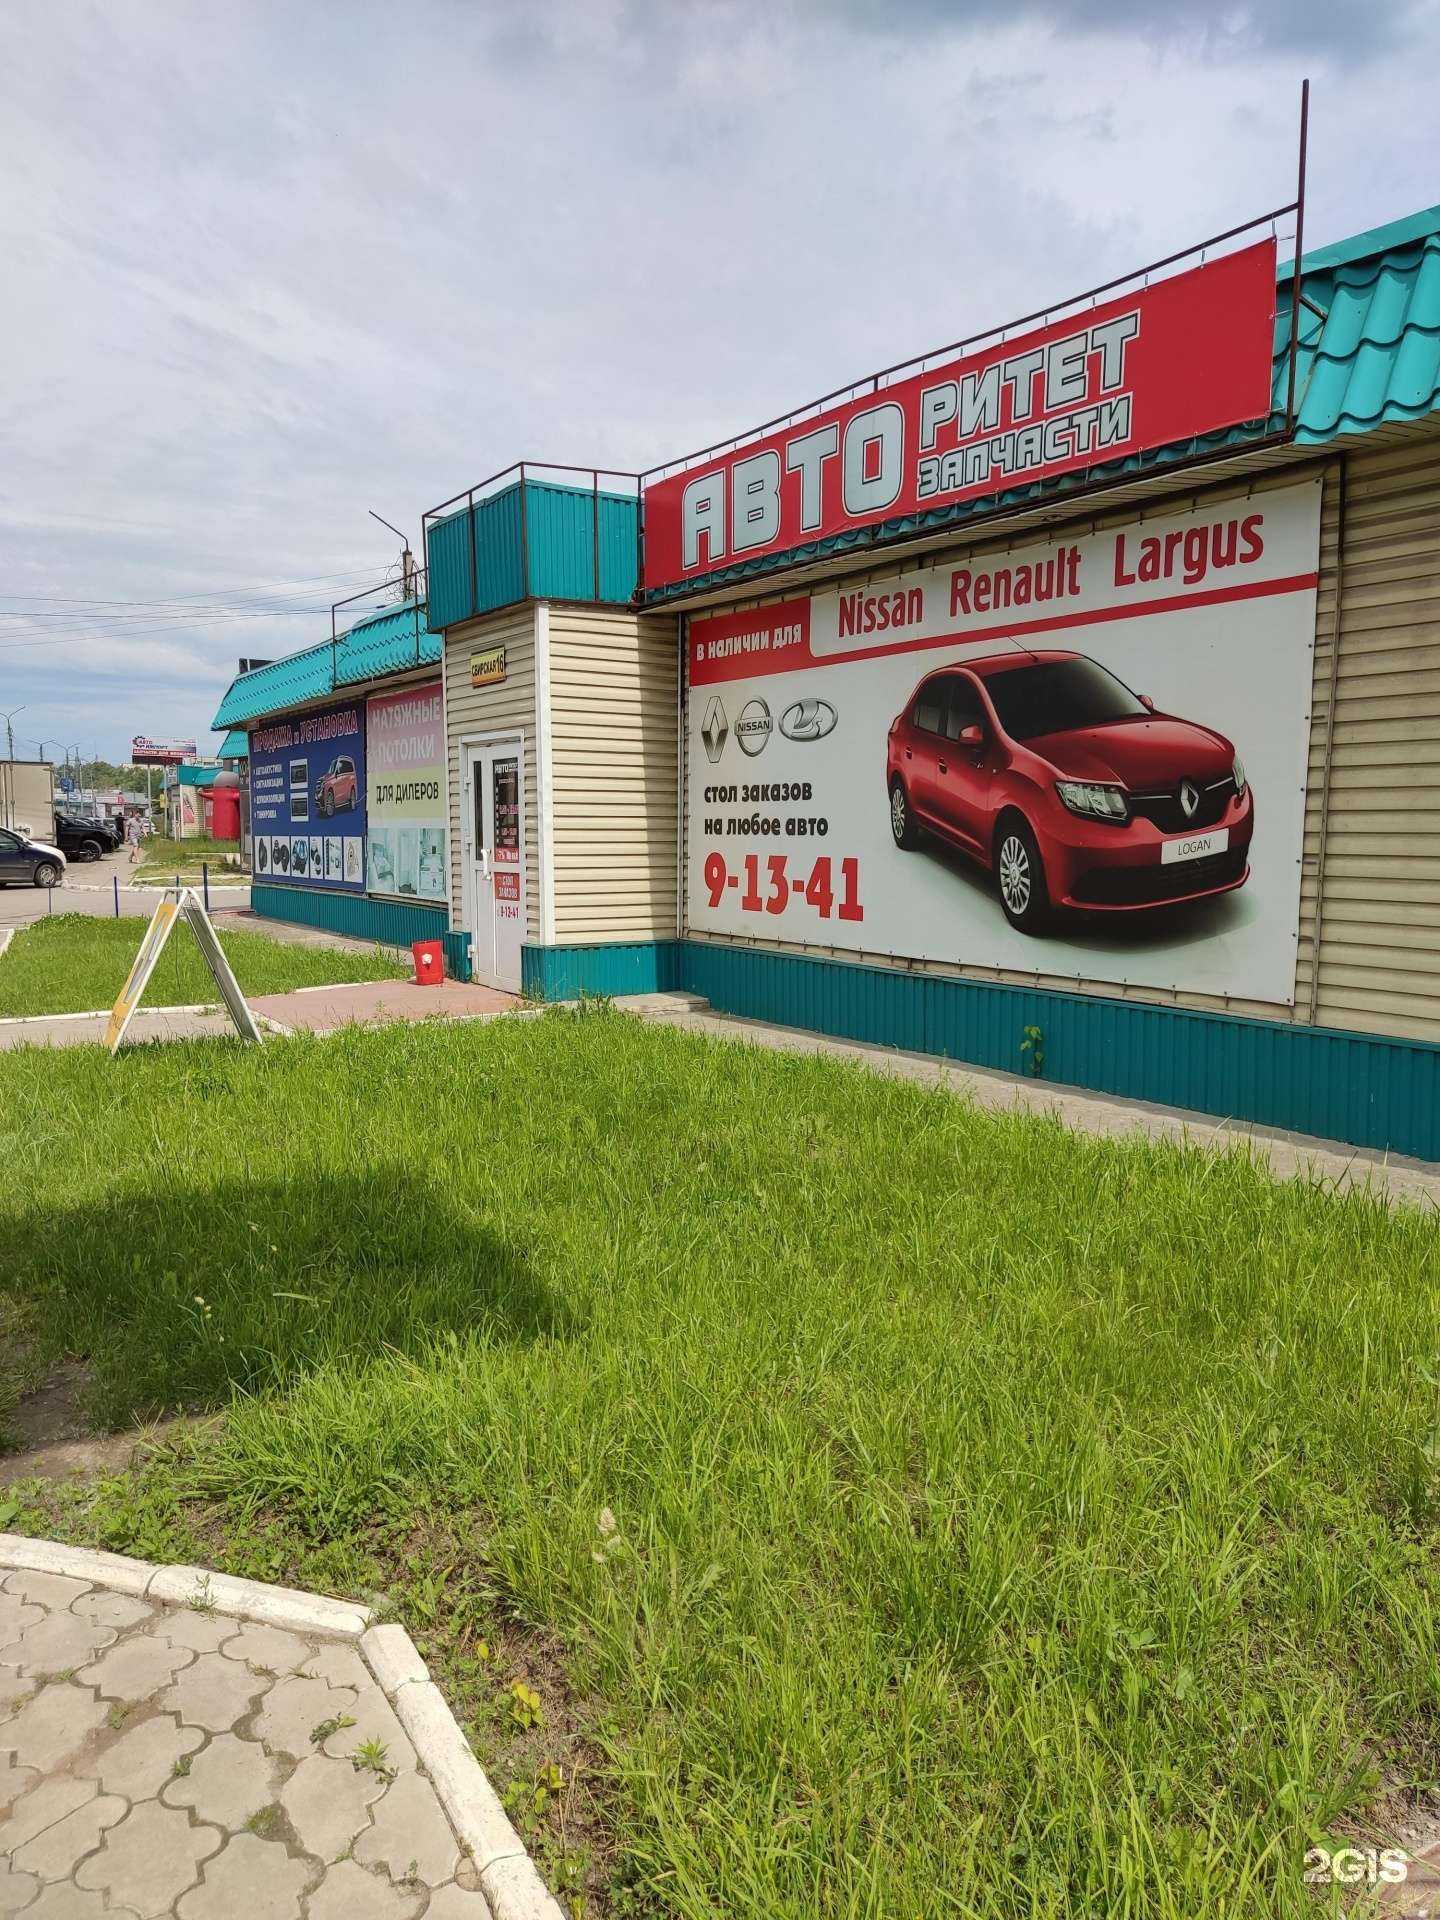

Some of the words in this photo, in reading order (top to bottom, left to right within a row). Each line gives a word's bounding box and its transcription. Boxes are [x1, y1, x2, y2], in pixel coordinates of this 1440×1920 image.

[919, 309, 1140, 451] РИТЕТ
[917, 393, 1133, 500] ЗАПЧАСТИ
[683, 403, 905, 570] АВТО
[839, 587, 923, 638] Nissan
[950, 547, 1082, 618] Renault
[1114, 514, 1264, 587] Largus
[708, 630, 770, 659] наличии
[773, 624, 802, 649] для
[496, 654, 504, 673] 16
[253, 725, 293, 753] ПРОДАЖА
[300, 710, 358, 744] УСТАНОВКА
[737, 719, 770, 733] NISSAN
[378, 735, 435, 763] ПОТОЛКИ
[376, 786, 394, 805] ДЛЯ
[395, 781, 439, 804] ДИЛЕРОВ
[704, 785, 738, 803] стол
[741, 782, 812, 802] заказов
[704, 817, 724, 836] на
[726, 813, 781, 836] любое
[785, 816, 829, 836] авто
[1178, 838, 1211, 856] LOGAN
[704, 851, 864, 922] 9-13-41
